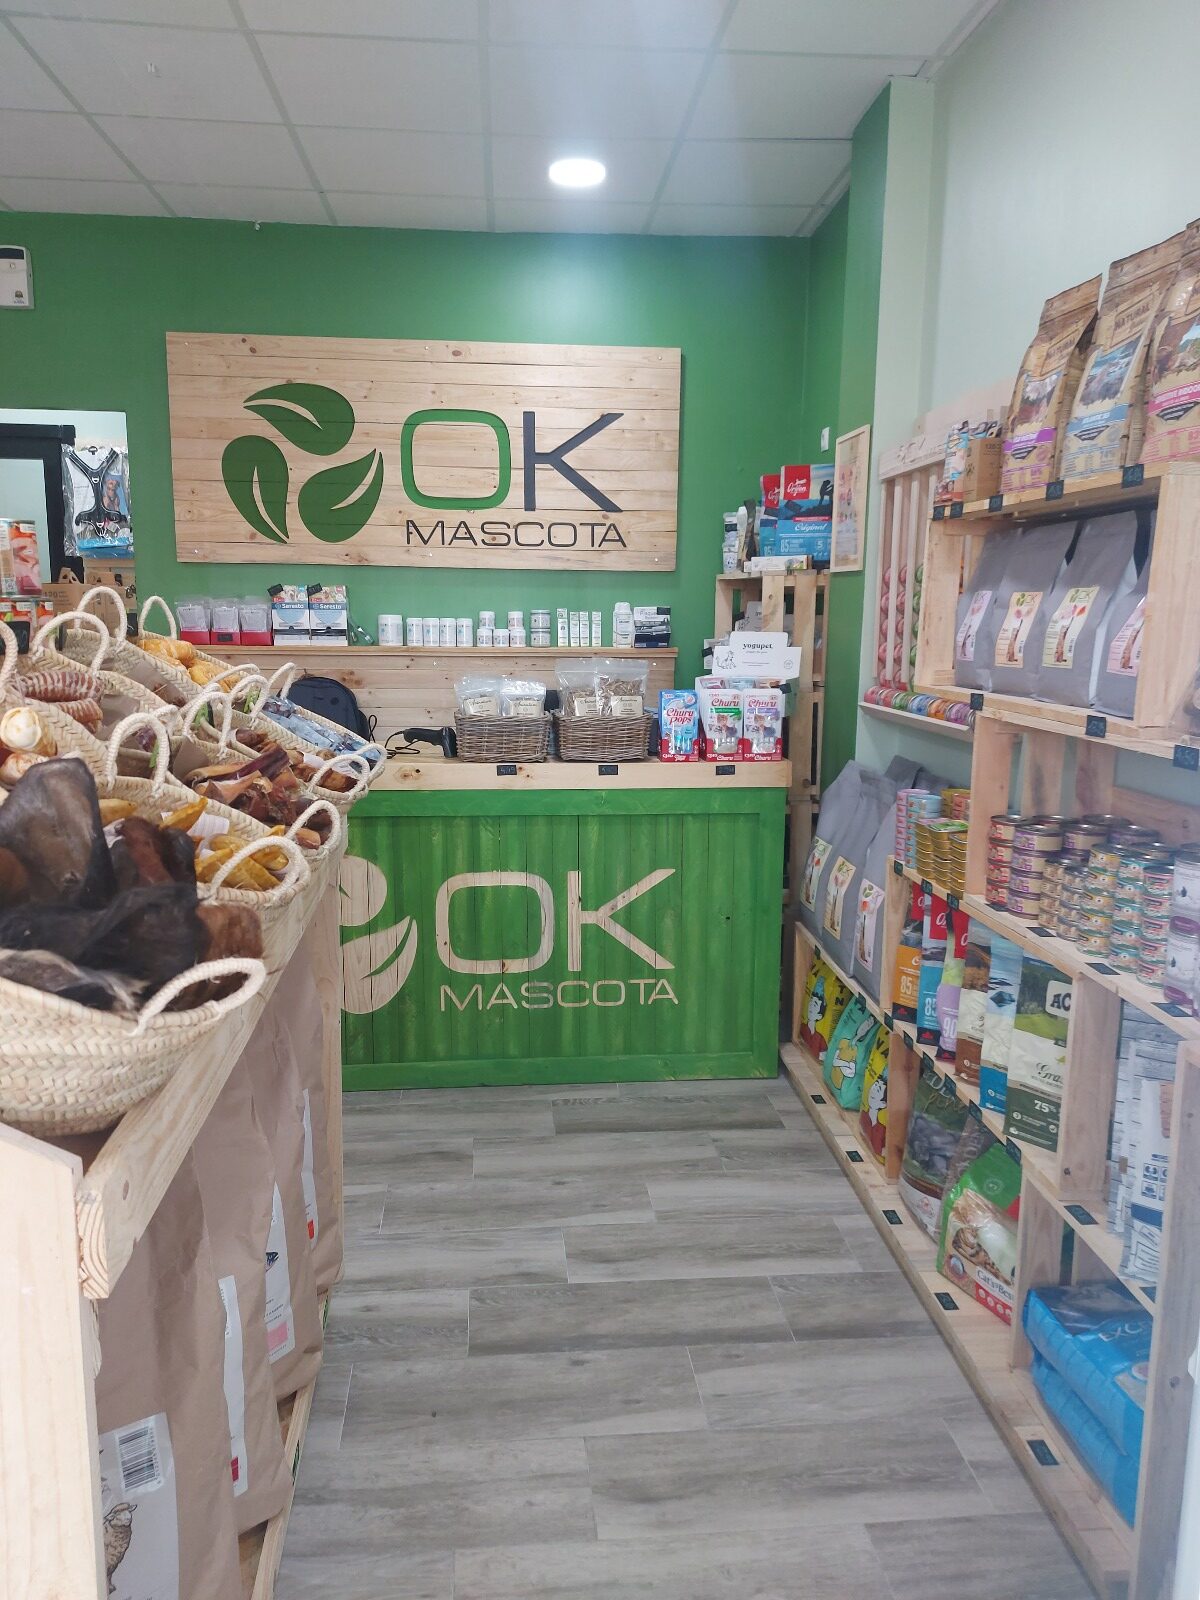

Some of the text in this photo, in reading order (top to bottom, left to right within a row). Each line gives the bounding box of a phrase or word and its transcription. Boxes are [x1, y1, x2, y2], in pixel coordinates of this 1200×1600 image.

[401, 409, 624, 512] OK
[405, 520, 627, 548] MASCOTA
[742, 642, 773, 650] yogupet
[711, 697, 740, 707] Churu
[748, 698, 777, 708] Churu
[666, 708, 694, 717] Churu
[435, 868, 676, 974] OK
[440, 978, 679, 1012] MASCOTA
